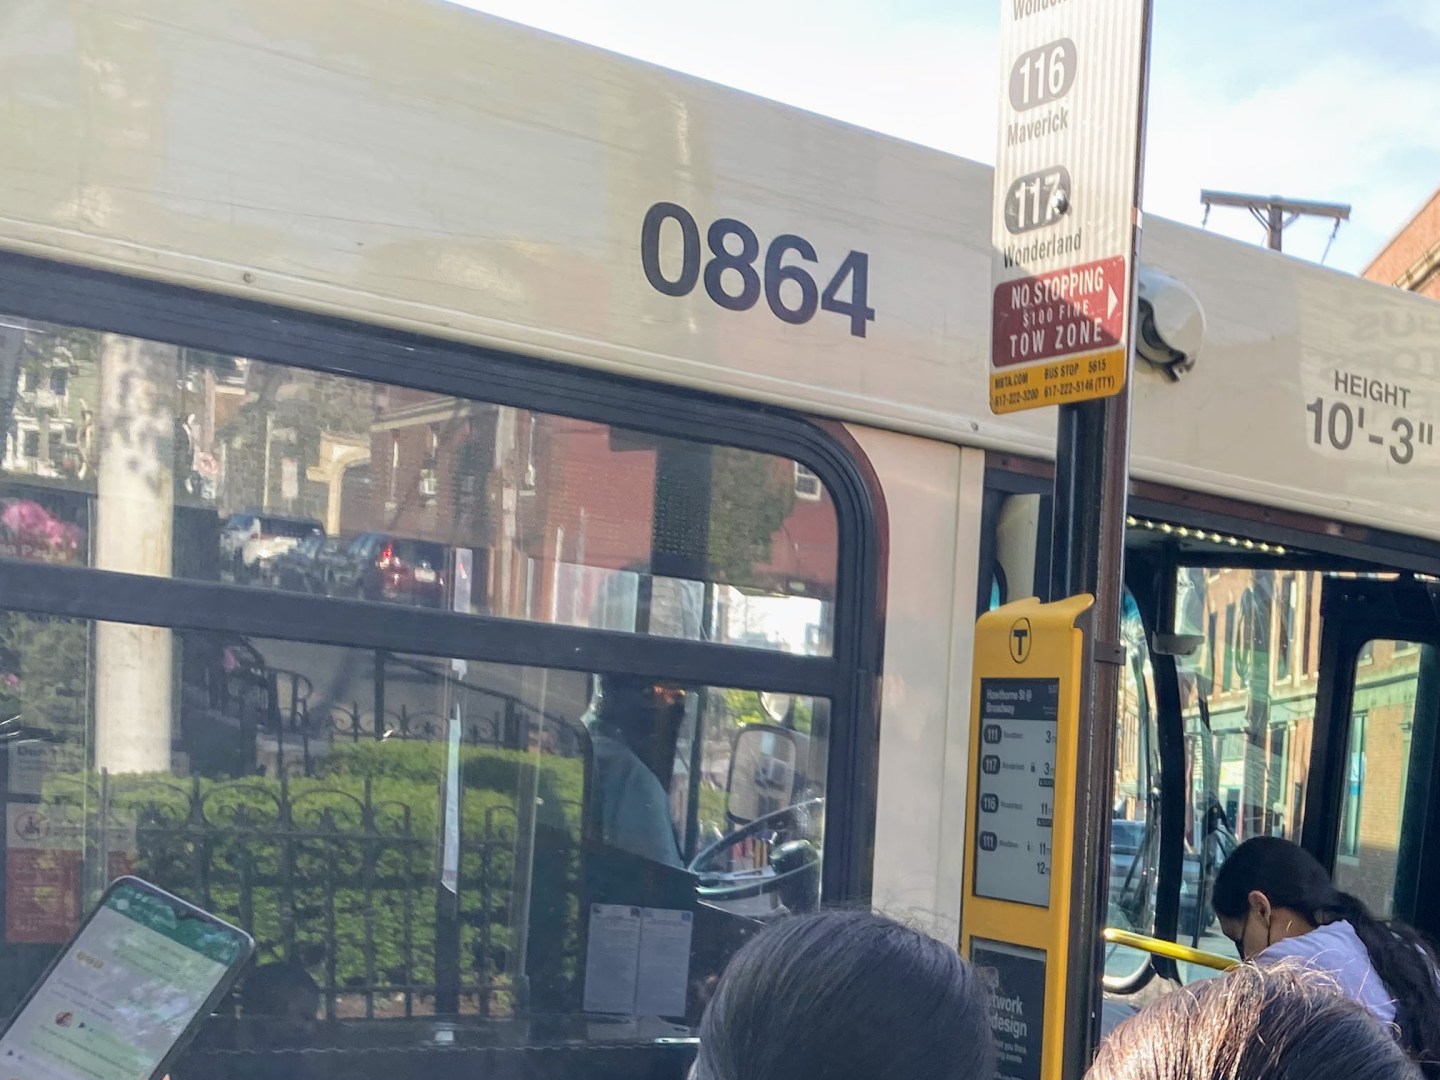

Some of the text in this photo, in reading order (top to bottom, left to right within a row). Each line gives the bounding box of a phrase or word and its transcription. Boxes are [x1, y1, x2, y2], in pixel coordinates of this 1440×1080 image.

[1019, 45, 1066, 104] 116
[1007, 107, 1069, 148] Maverick
[1014, 172, 1062, 229] 117
[1003, 228, 1082, 269] Wonderland
[641, 201, 876, 338] 0864
[1011, 266, 1104, 310] NO STOPPING
[1009, 317, 1103, 358] TOW ZONE
[1022, 307, 1053, 329] $100
[1044, 366, 1058, 380] BUS
[1060, 362, 1080, 378] STOP
[1334, 370, 1411, 408] HEIGHT
[1306, 396, 1434, 465] 10'-3"
[986, 758, 998, 772] 117
